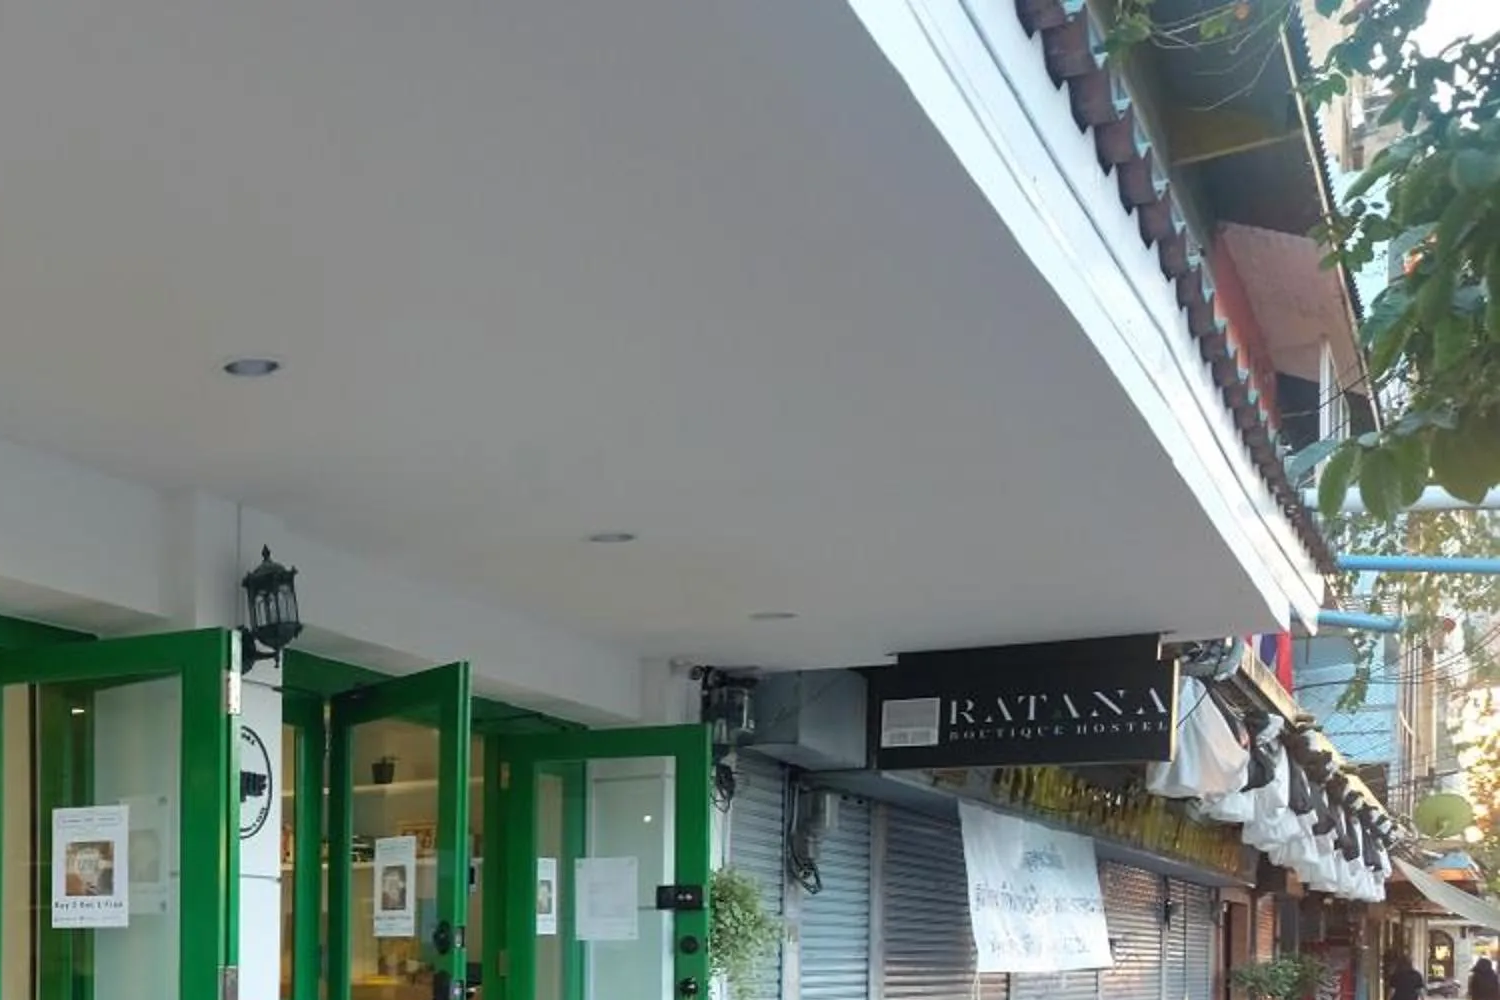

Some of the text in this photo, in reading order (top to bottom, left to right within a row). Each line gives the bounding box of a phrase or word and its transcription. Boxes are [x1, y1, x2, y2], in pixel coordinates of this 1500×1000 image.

[949, 687, 1168, 725] RATANA
[949, 725, 1065, 740] BOUTIQUE
[1077, 720, 1168, 735] HOSTEL
